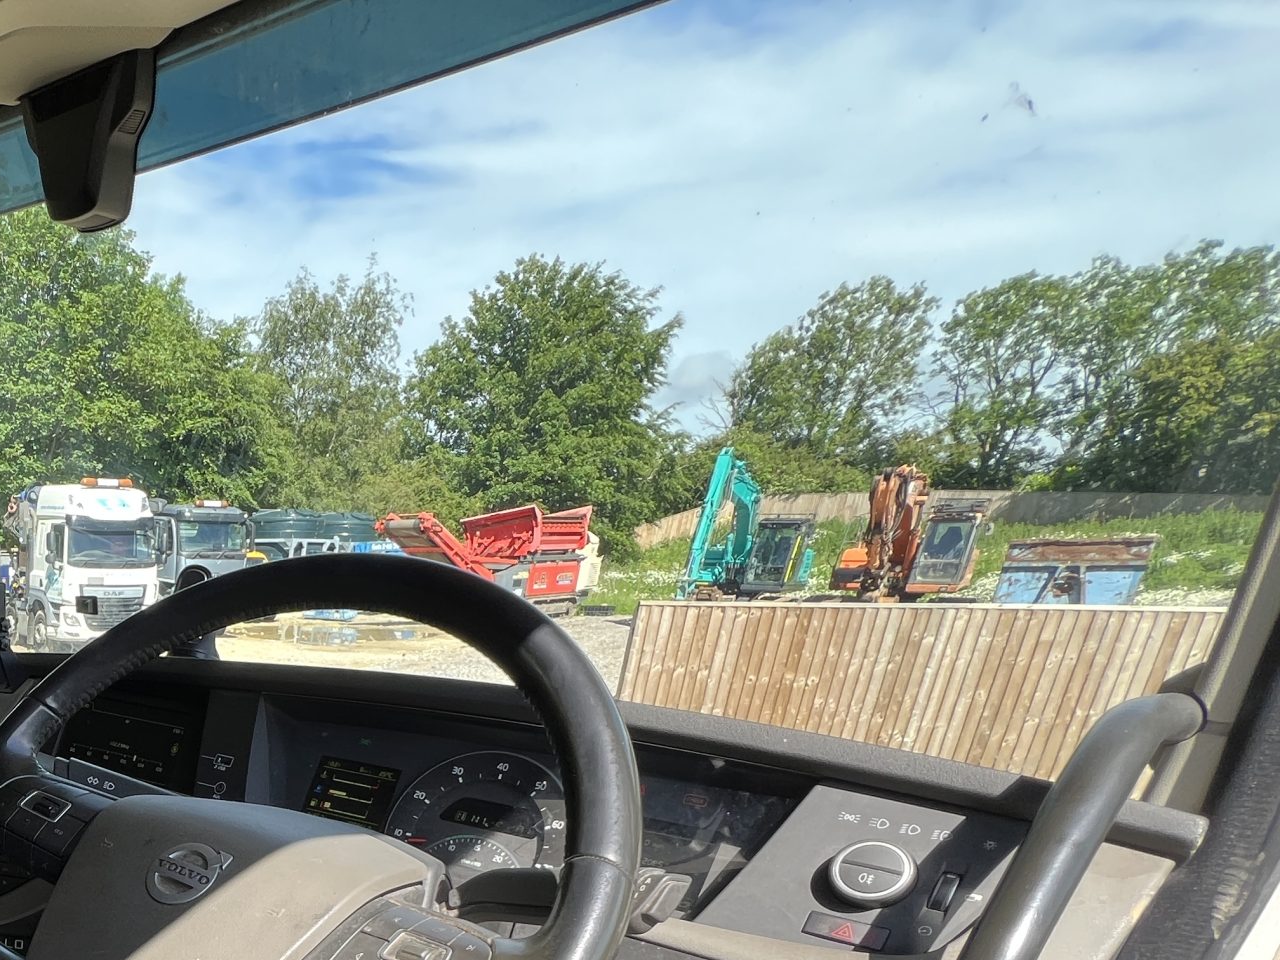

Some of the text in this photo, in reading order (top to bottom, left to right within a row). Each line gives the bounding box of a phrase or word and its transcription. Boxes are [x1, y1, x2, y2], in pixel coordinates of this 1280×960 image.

[451, 766, 464, 776] 30
[496, 762, 509, 772] 40
[534, 781, 548, 791] 50
[413, 790, 426, 800] 20
[551, 820, 565, 830] 60
[394, 828, 403, 837] 10
[492, 855, 504, 864] 20
[158, 859, 211, 885] VOLVO
